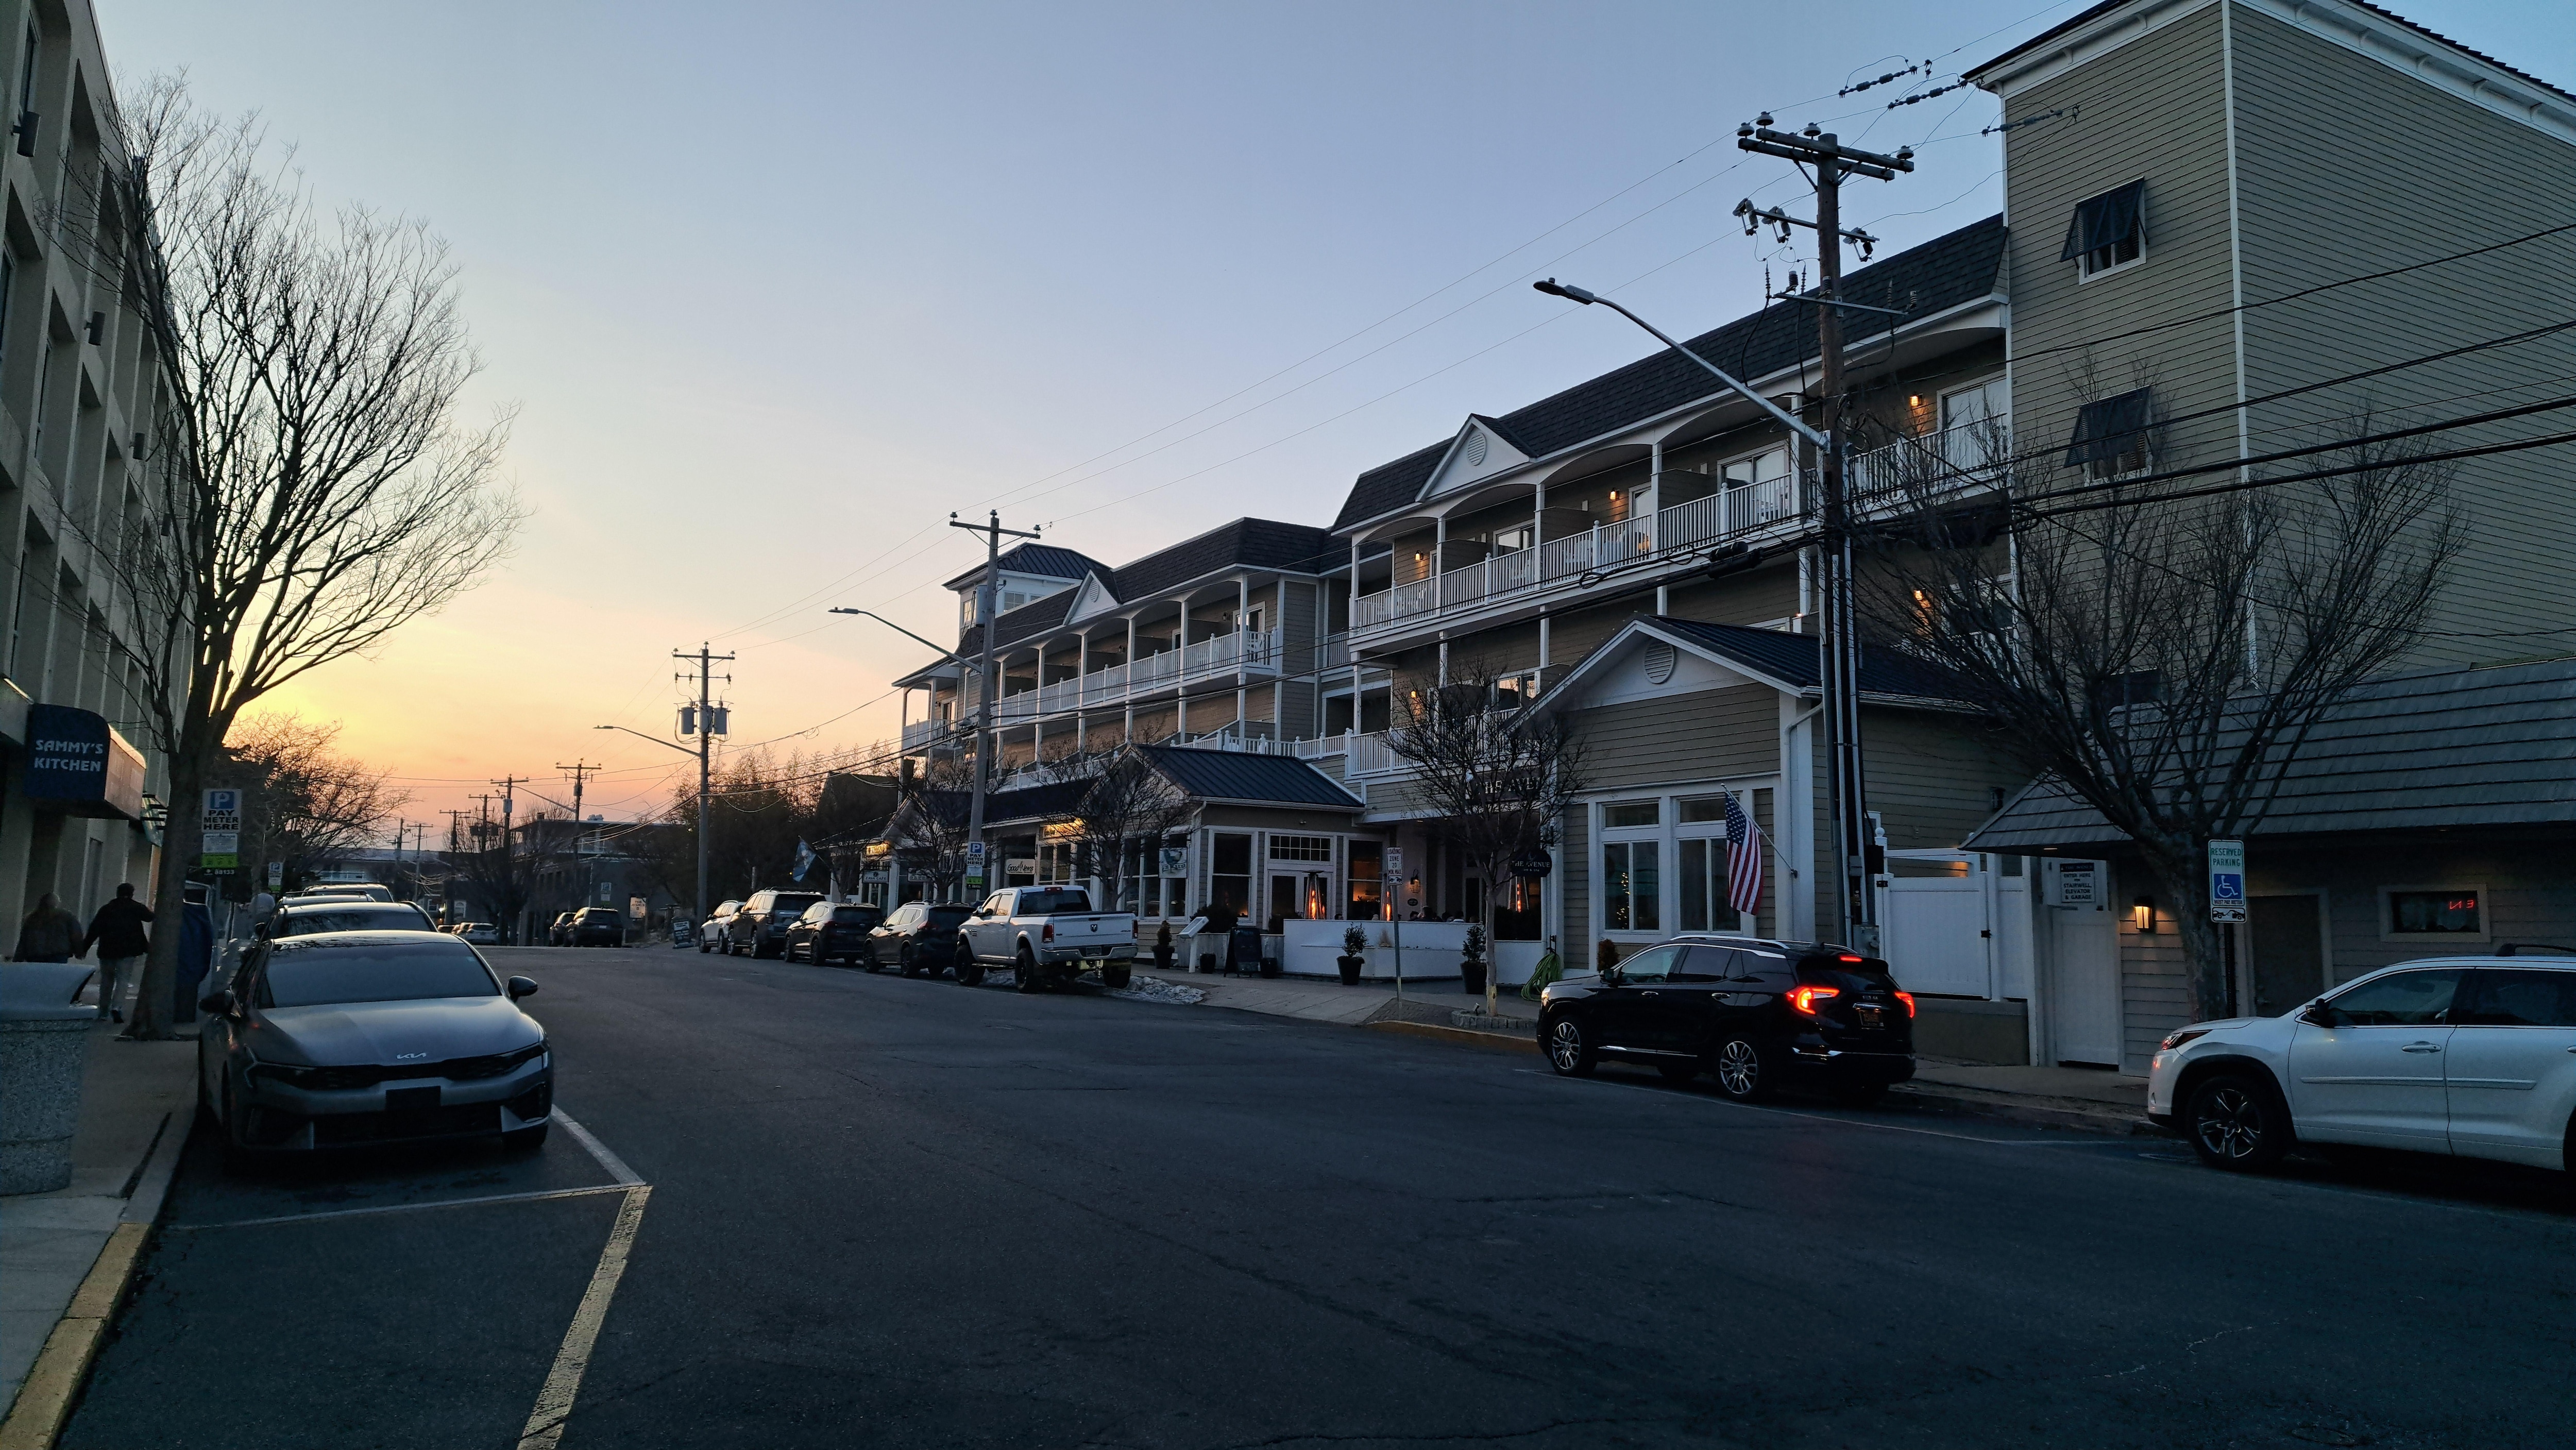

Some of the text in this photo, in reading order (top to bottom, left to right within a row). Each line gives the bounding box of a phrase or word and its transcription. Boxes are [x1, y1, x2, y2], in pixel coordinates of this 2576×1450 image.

[36, 739, 103, 754] SAMMY'S
[34, 756, 101, 772] KITCHEN
[214, 793, 230, 808] P
[972, 844, 980, 852] P
[1007, 864, 1020, 872] Good
